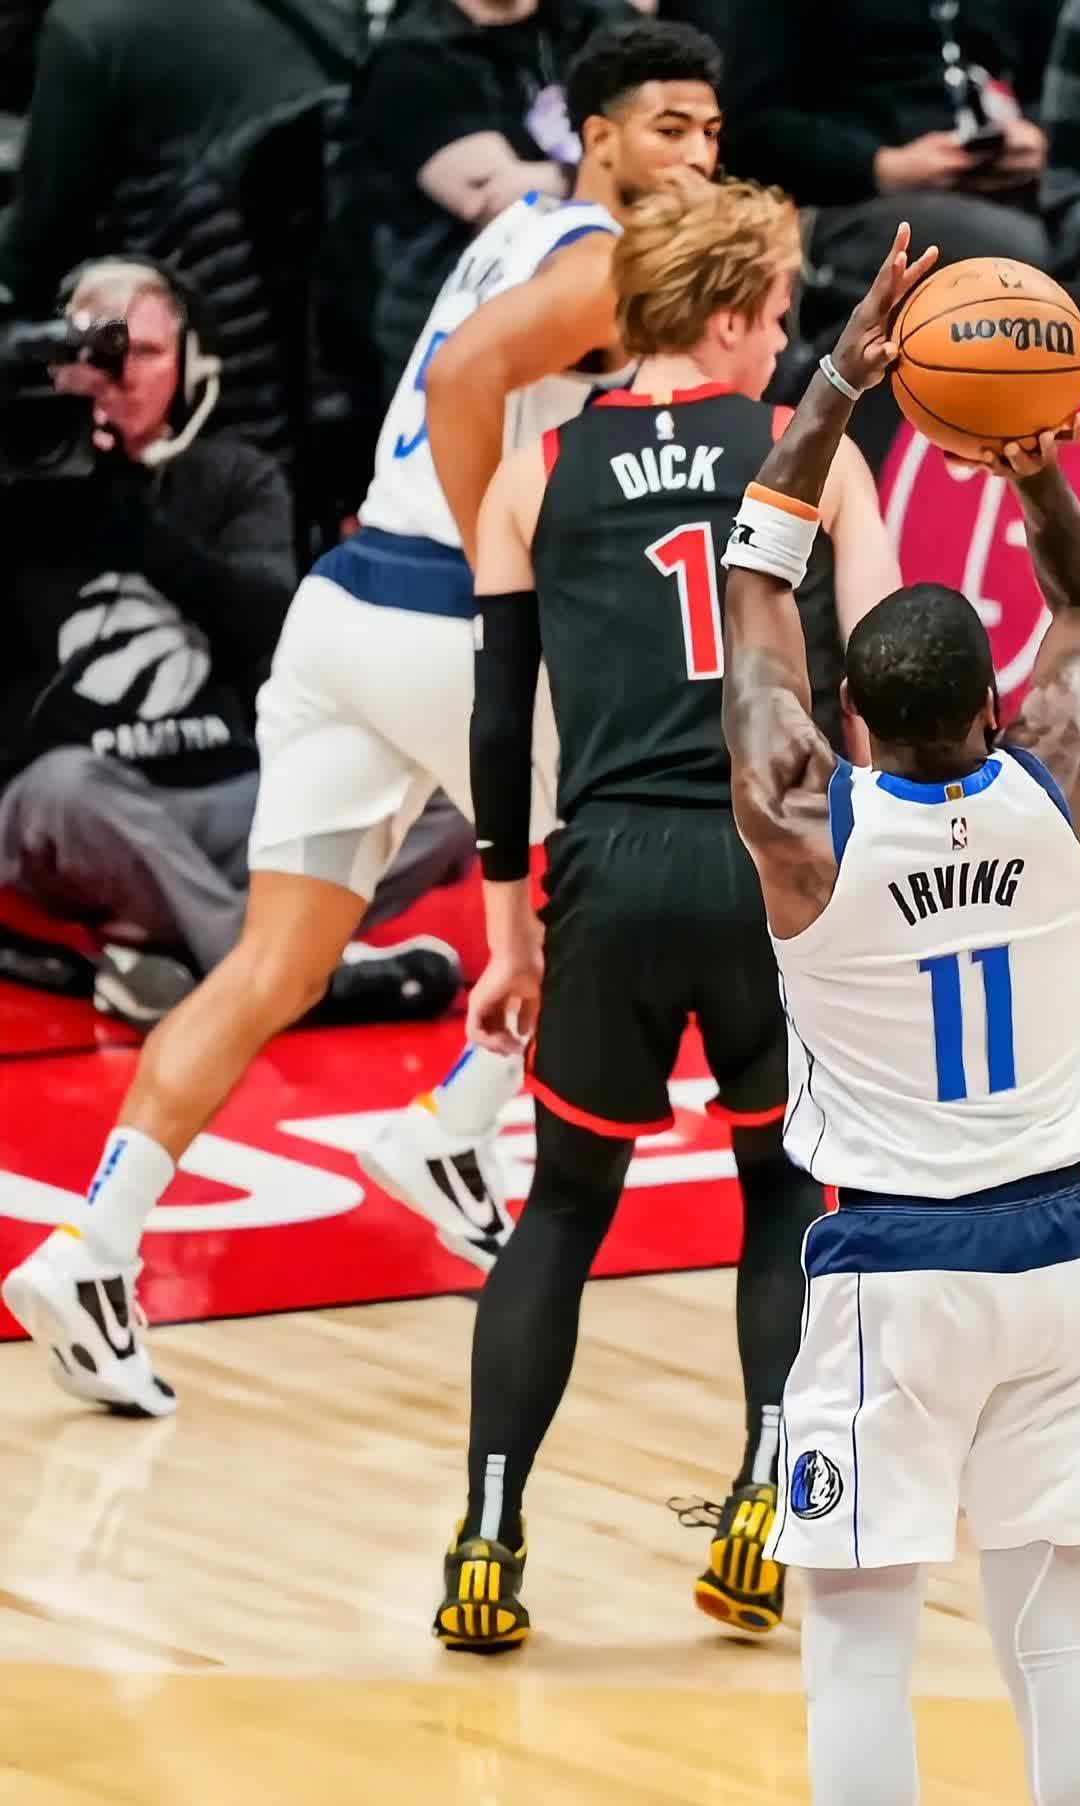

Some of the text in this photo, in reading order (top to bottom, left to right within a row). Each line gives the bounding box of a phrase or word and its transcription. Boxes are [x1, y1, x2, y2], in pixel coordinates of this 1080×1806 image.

[951, 317, 1075, 356] Wilson
[610, 444, 724, 500] DICK
[644, 521, 724, 680] 1
[888, 858, 1025, 926] IRVING
[917, 942, 1017, 1103] 11
